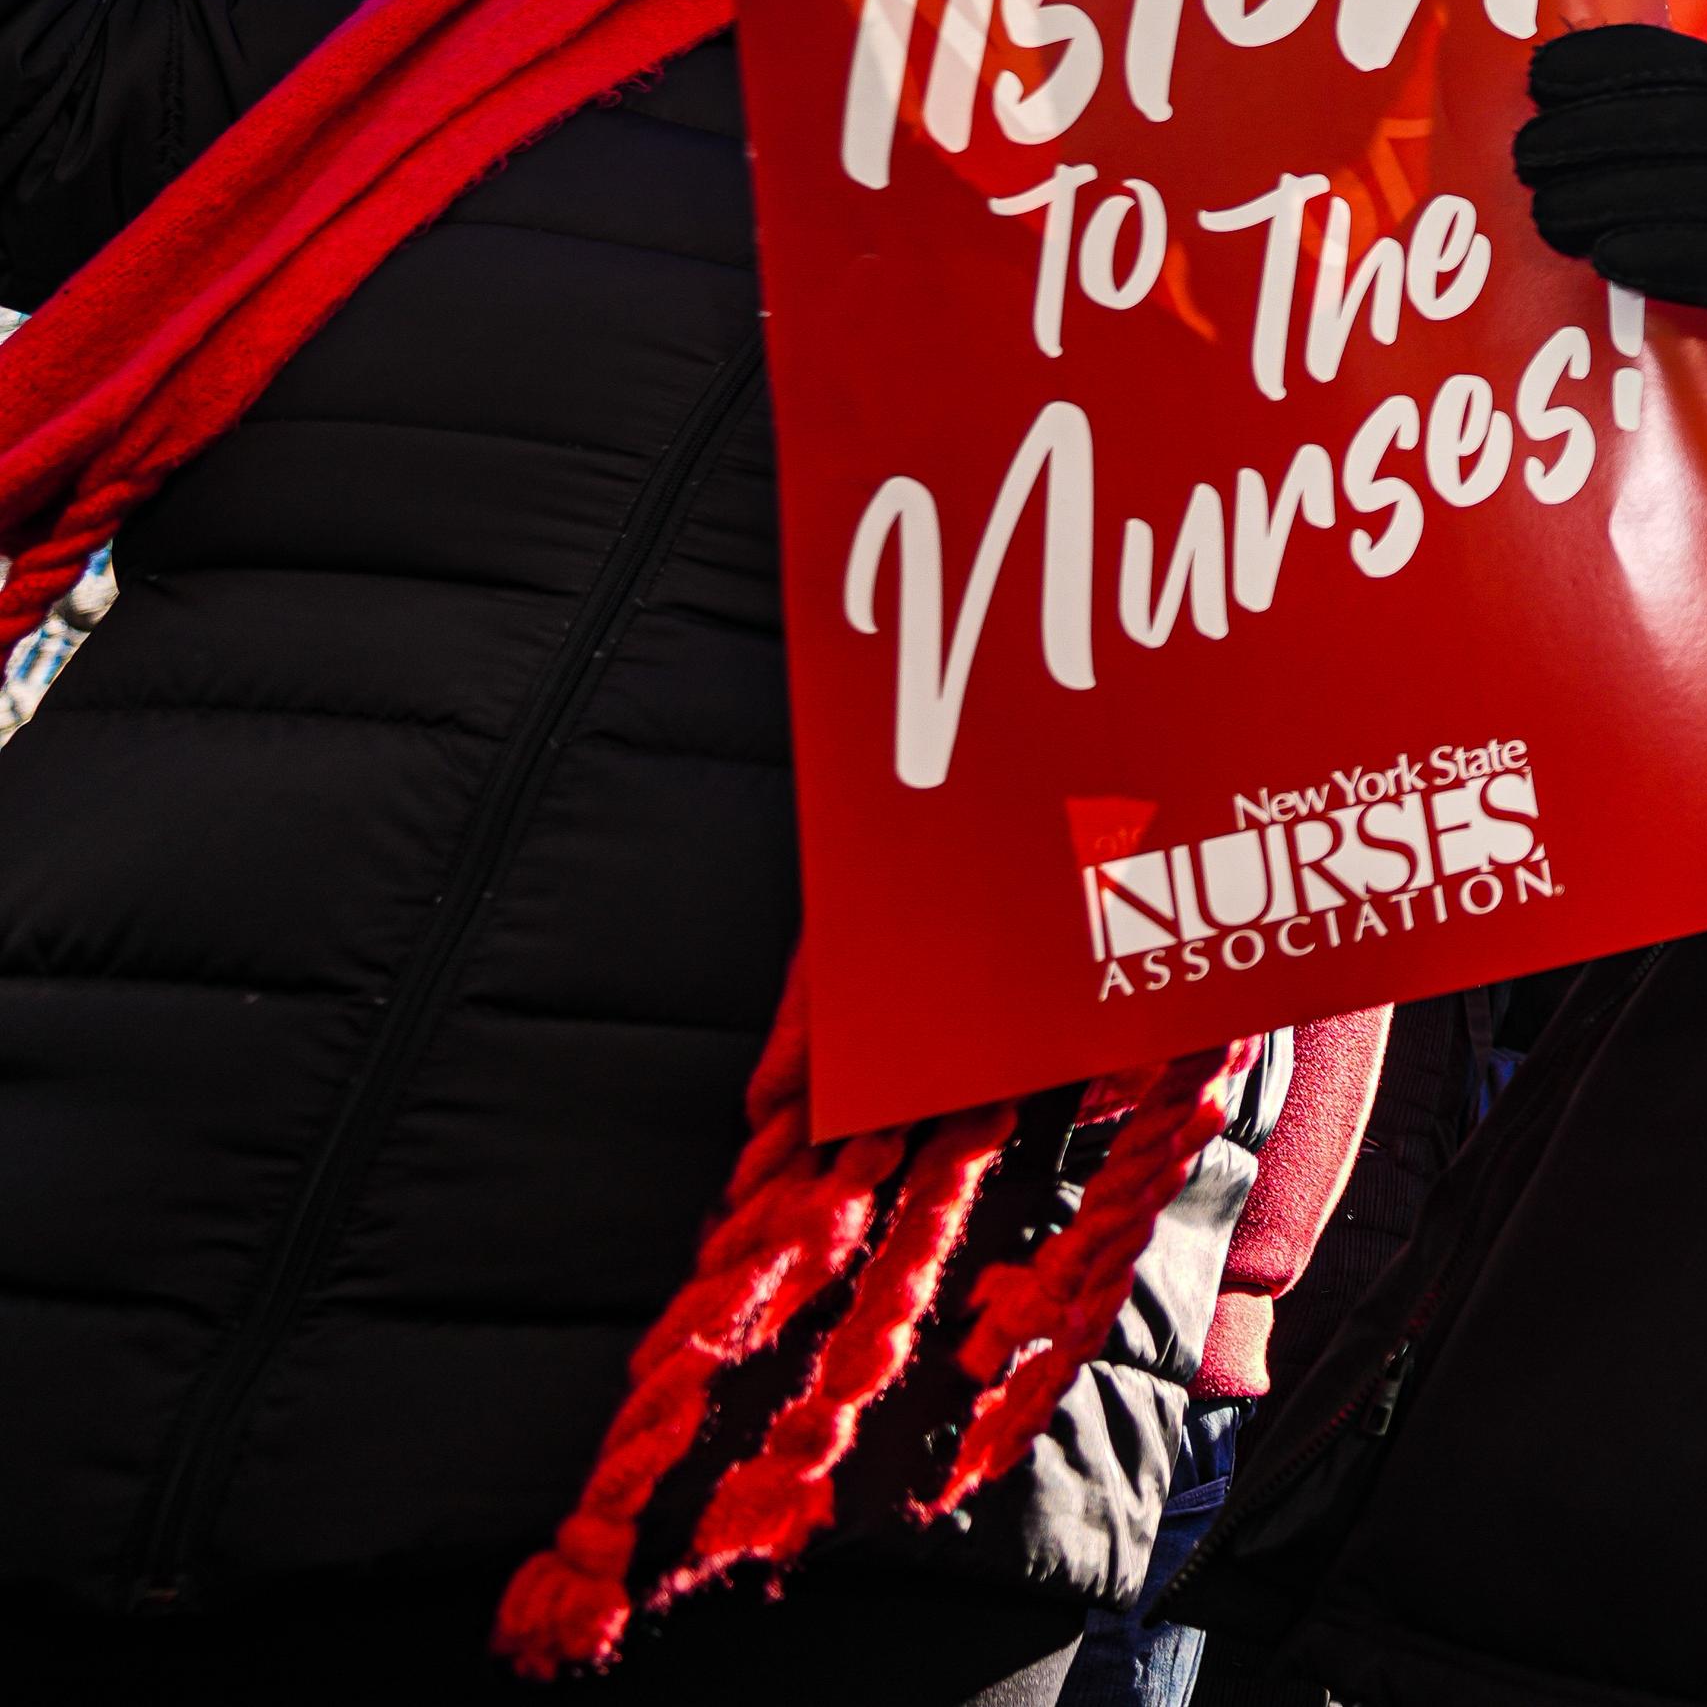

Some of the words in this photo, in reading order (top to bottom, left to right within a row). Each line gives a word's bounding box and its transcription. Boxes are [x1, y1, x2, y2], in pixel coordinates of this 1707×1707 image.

[1233, 786, 1331, 831] New
[1332, 753, 1424, 807] York
[1429, 738, 1527, 787] State
[1082, 766, 1541, 962] NURSES
[1098, 859, 1553, 1003] ASSOCIATION
